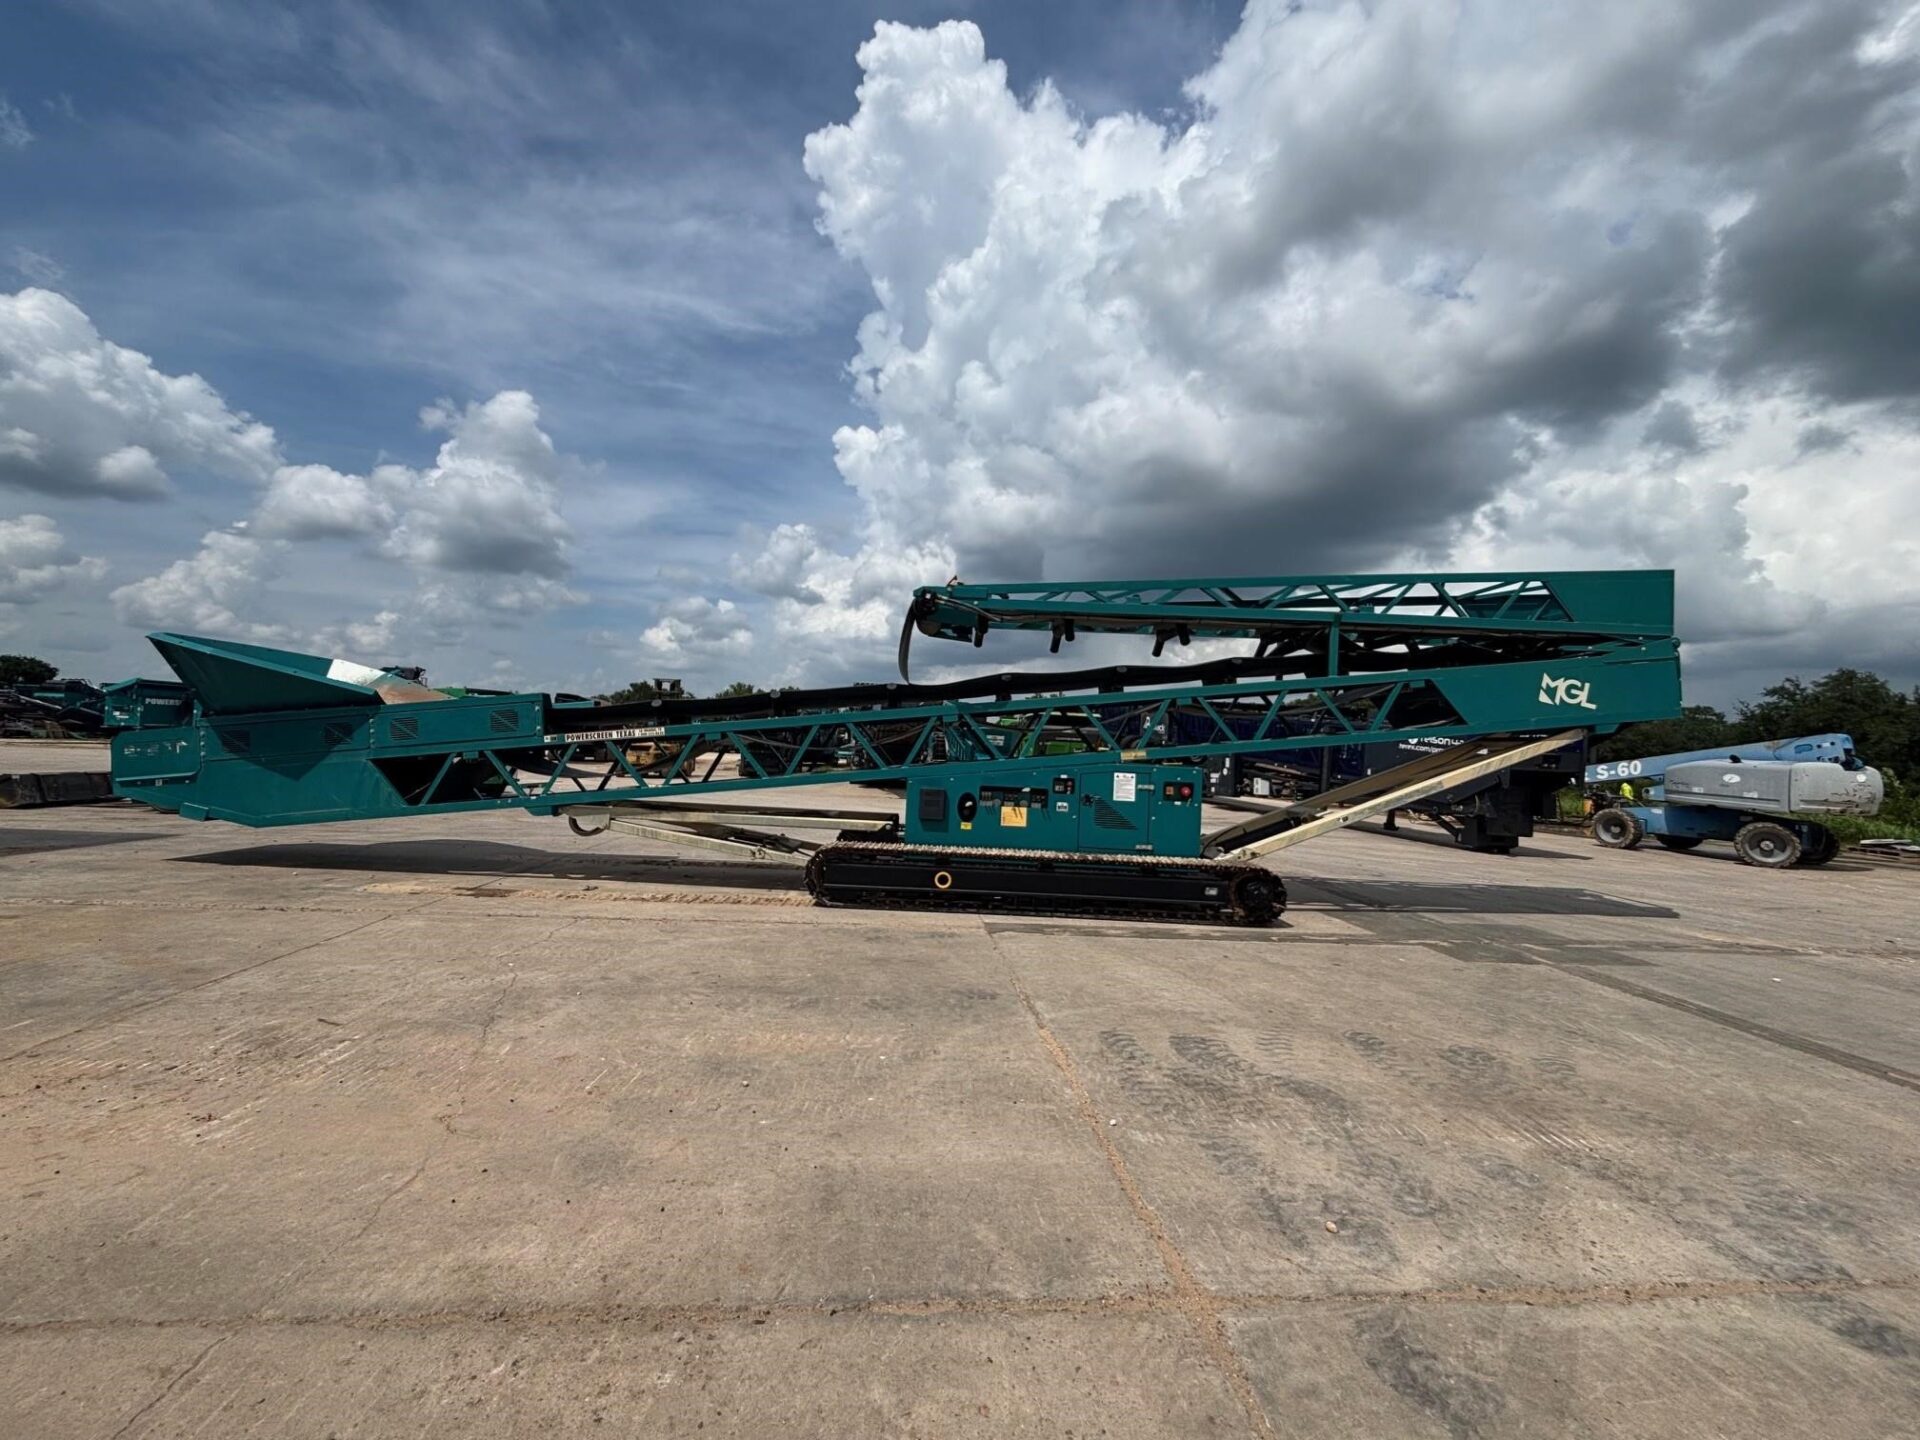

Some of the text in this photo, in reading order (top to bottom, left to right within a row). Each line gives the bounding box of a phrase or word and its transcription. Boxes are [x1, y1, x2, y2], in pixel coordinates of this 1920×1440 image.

[1538, 672, 1597, 710] MGL
[566, 731, 613, 741] POWERSCREEN
[616, 729, 636, 738] TEXAS
[1596, 760, 1642, 779] S-60
